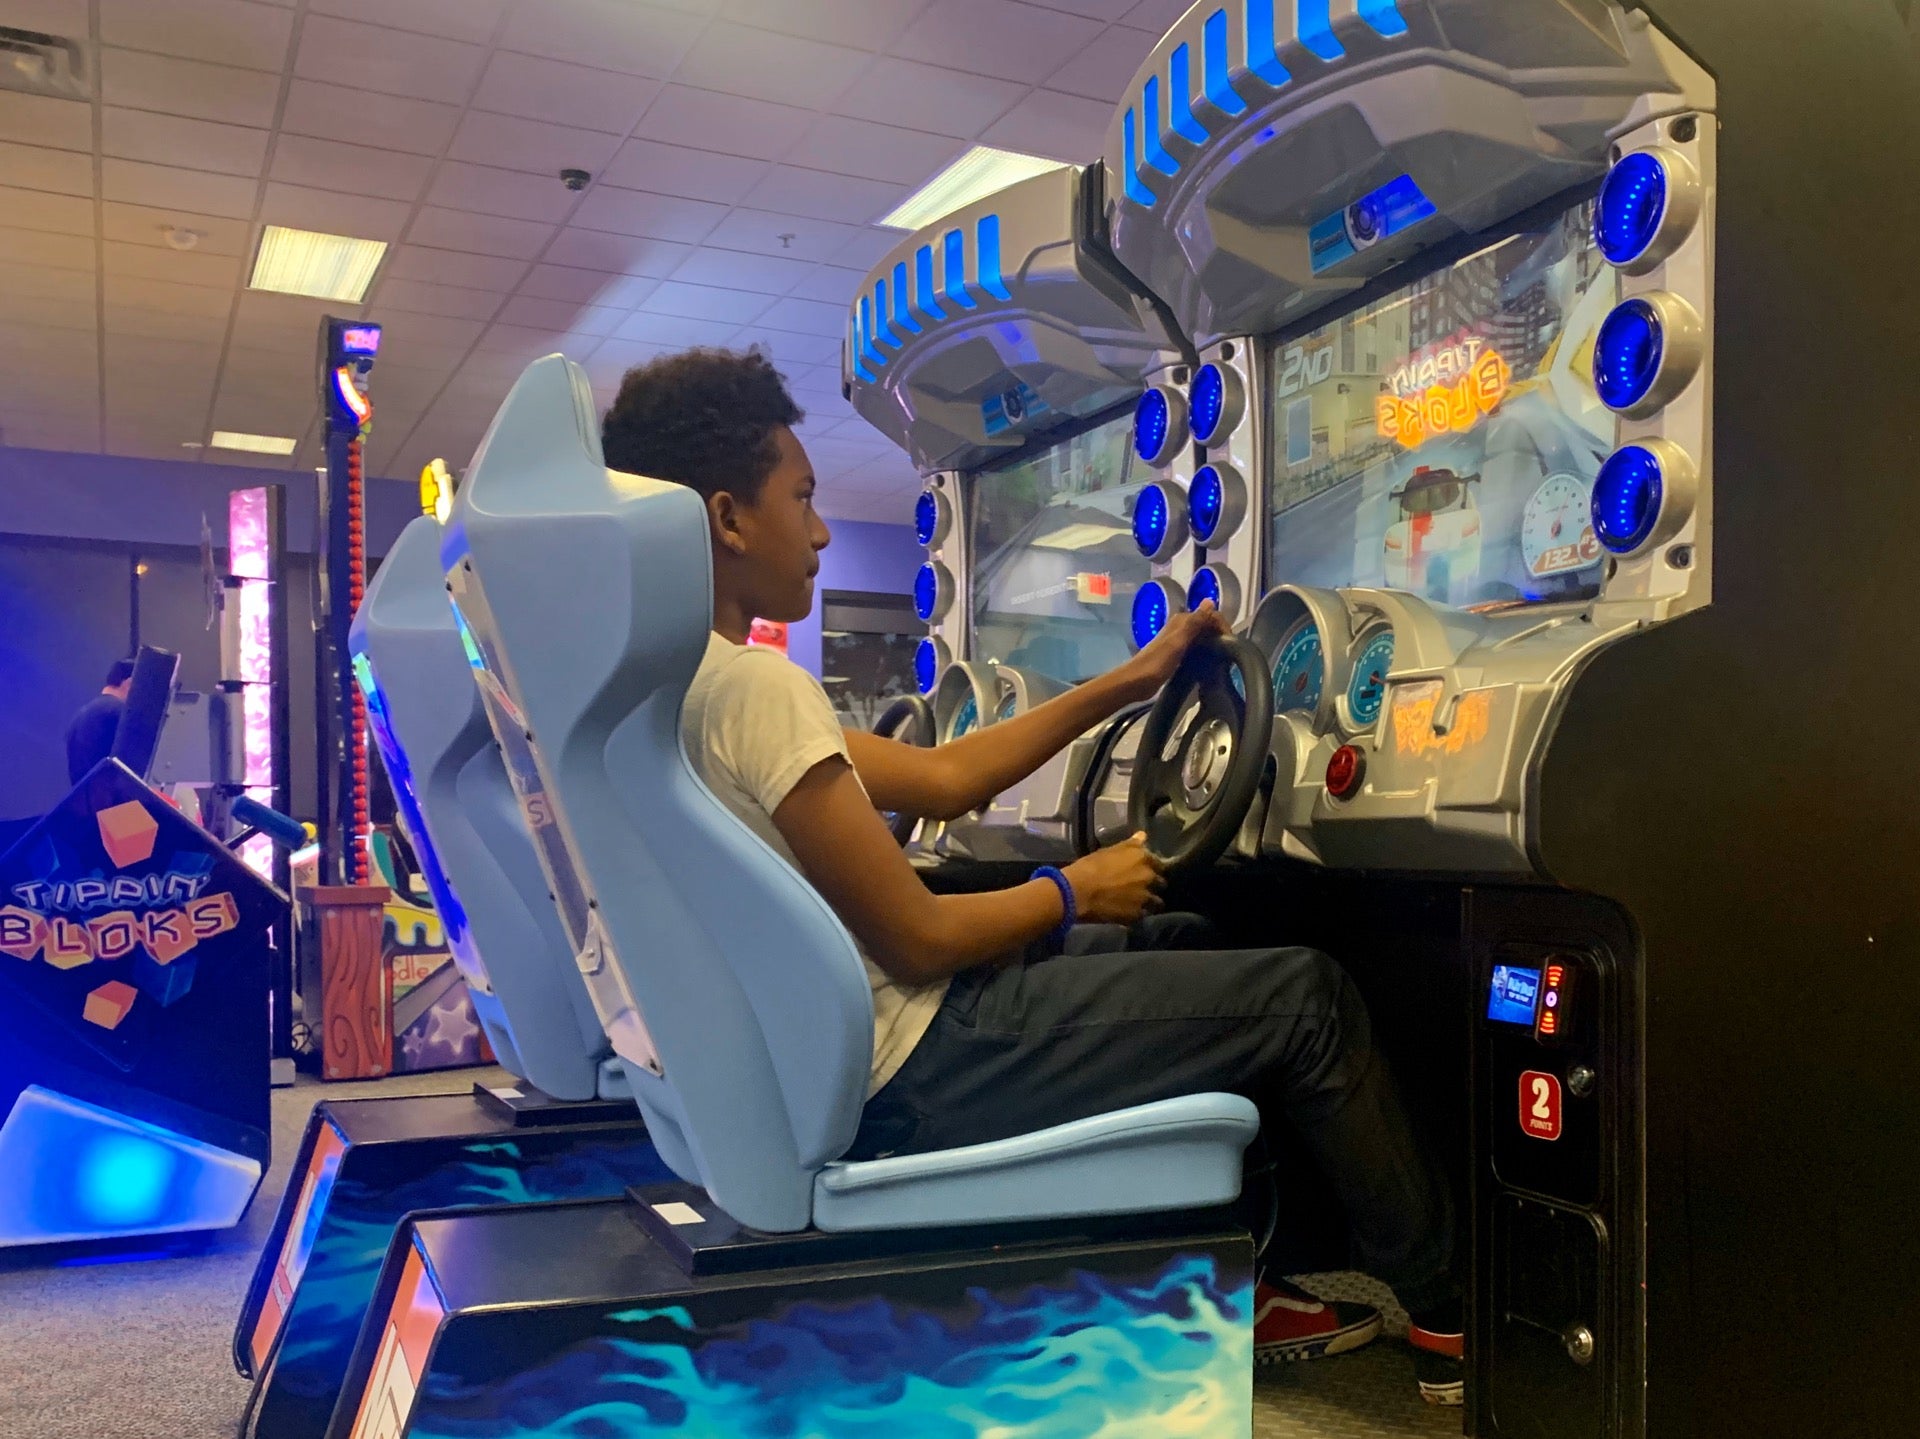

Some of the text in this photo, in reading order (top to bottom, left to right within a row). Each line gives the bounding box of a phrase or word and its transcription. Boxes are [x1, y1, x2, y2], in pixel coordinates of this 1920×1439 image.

[1279, 346, 1333, 398] 2ND
[1545, 547, 1572, 569] 132
[0, 903, 223, 957] BLOKS
[393, 955, 429, 980] dle
[1532, 1077, 1550, 1119] 2
